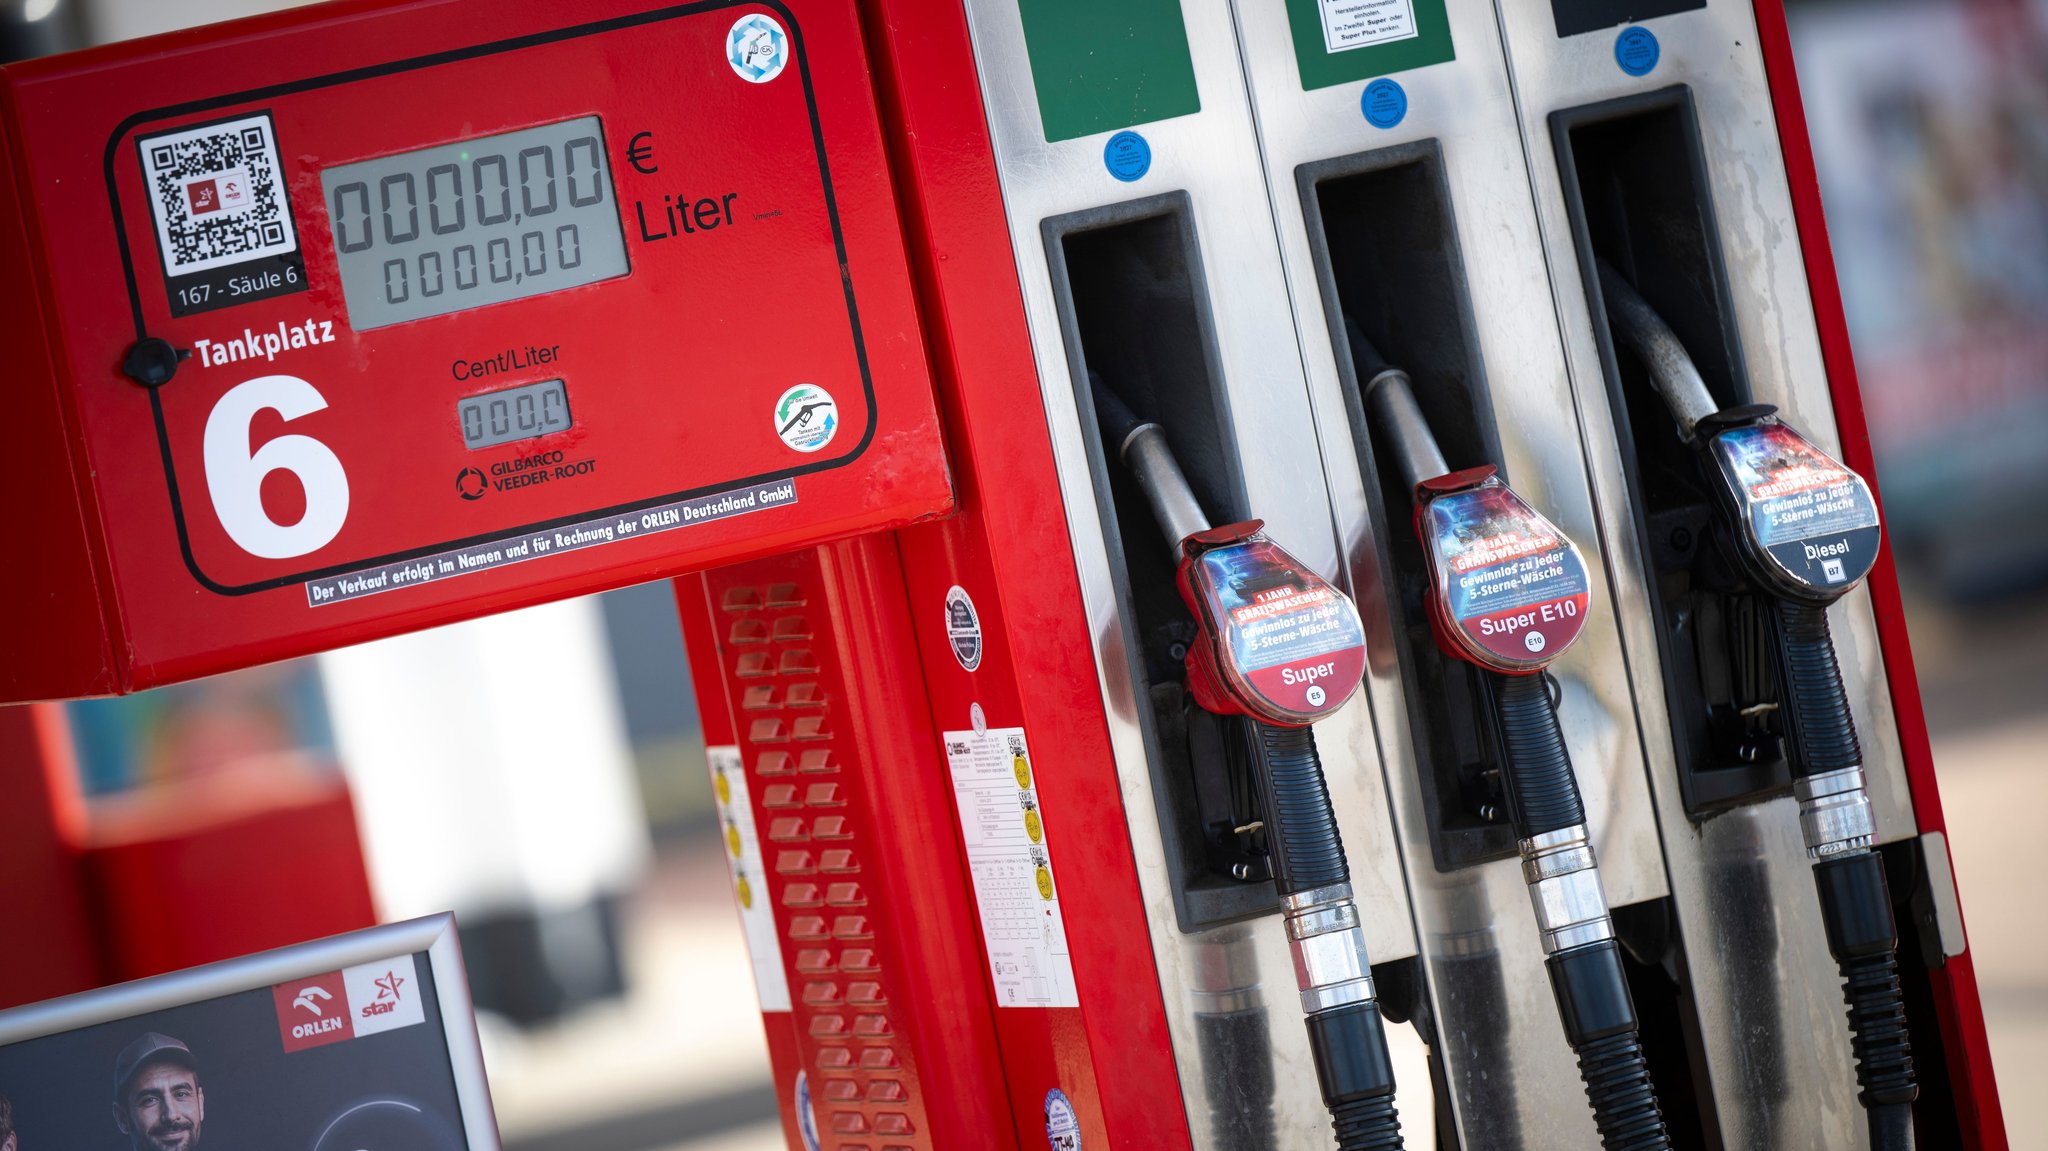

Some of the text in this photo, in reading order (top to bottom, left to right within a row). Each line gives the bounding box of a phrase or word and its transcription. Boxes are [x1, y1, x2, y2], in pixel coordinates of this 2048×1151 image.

[1341, 32, 1360, 41] Super
[1362, 29, 1377, 37] Plus
[1343, 21, 1364, 30] Zweifel
[1367, 17, 1387, 26] Super
[1389, 14, 1403, 22] oder
[626, 131, 658, 174] €
[635, 191, 738, 243] Liter
[179, 284, 211, 306] 167
[229, 271, 281, 296] Säule
[286, 266, 298, 284] 6
[195, 319, 336, 368] Tankplatz
[452, 345, 560, 381] Cent/Liter
[203, 375, 350, 558] 6
[490, 450, 564, 476] GILBARCO
[493, 460, 596, 492] VEEDER-ROOT
[1762, 496, 1813, 515] Gewinnlos
[1815, 491, 1827, 502] zu
[1771, 498, 1855, 527] 5-Sterne-Wäsche
[312, 485, 793, 602] Der Verkauf erfolgt im Namen und für Rechnung der ORLEN Deutschland GmbH
[1805, 538, 1850, 560] Diesel
[1460, 551, 1564, 588] Gewinnlos zu jeder
[1469, 565, 1564, 600] 5-Sterne-Wäsche
[1828, 566, 1839, 576] B7
[1265, 587, 1293, 602] JAHR
[1241, 618, 1296, 640] Gewinnlos
[1299, 614, 1311, 625] zu
[1480, 600, 1577, 636] Super E10
[1250, 619, 1340, 651] 5-Sterne-Wäsche
[1528, 637, 1542, 646] E10
[1281, 661, 1335, 685] Super
[1311, 691, 1321, 700] E5
[362, 1000, 396, 1018] star
[292, 1016, 342, 1039] ORLEN
